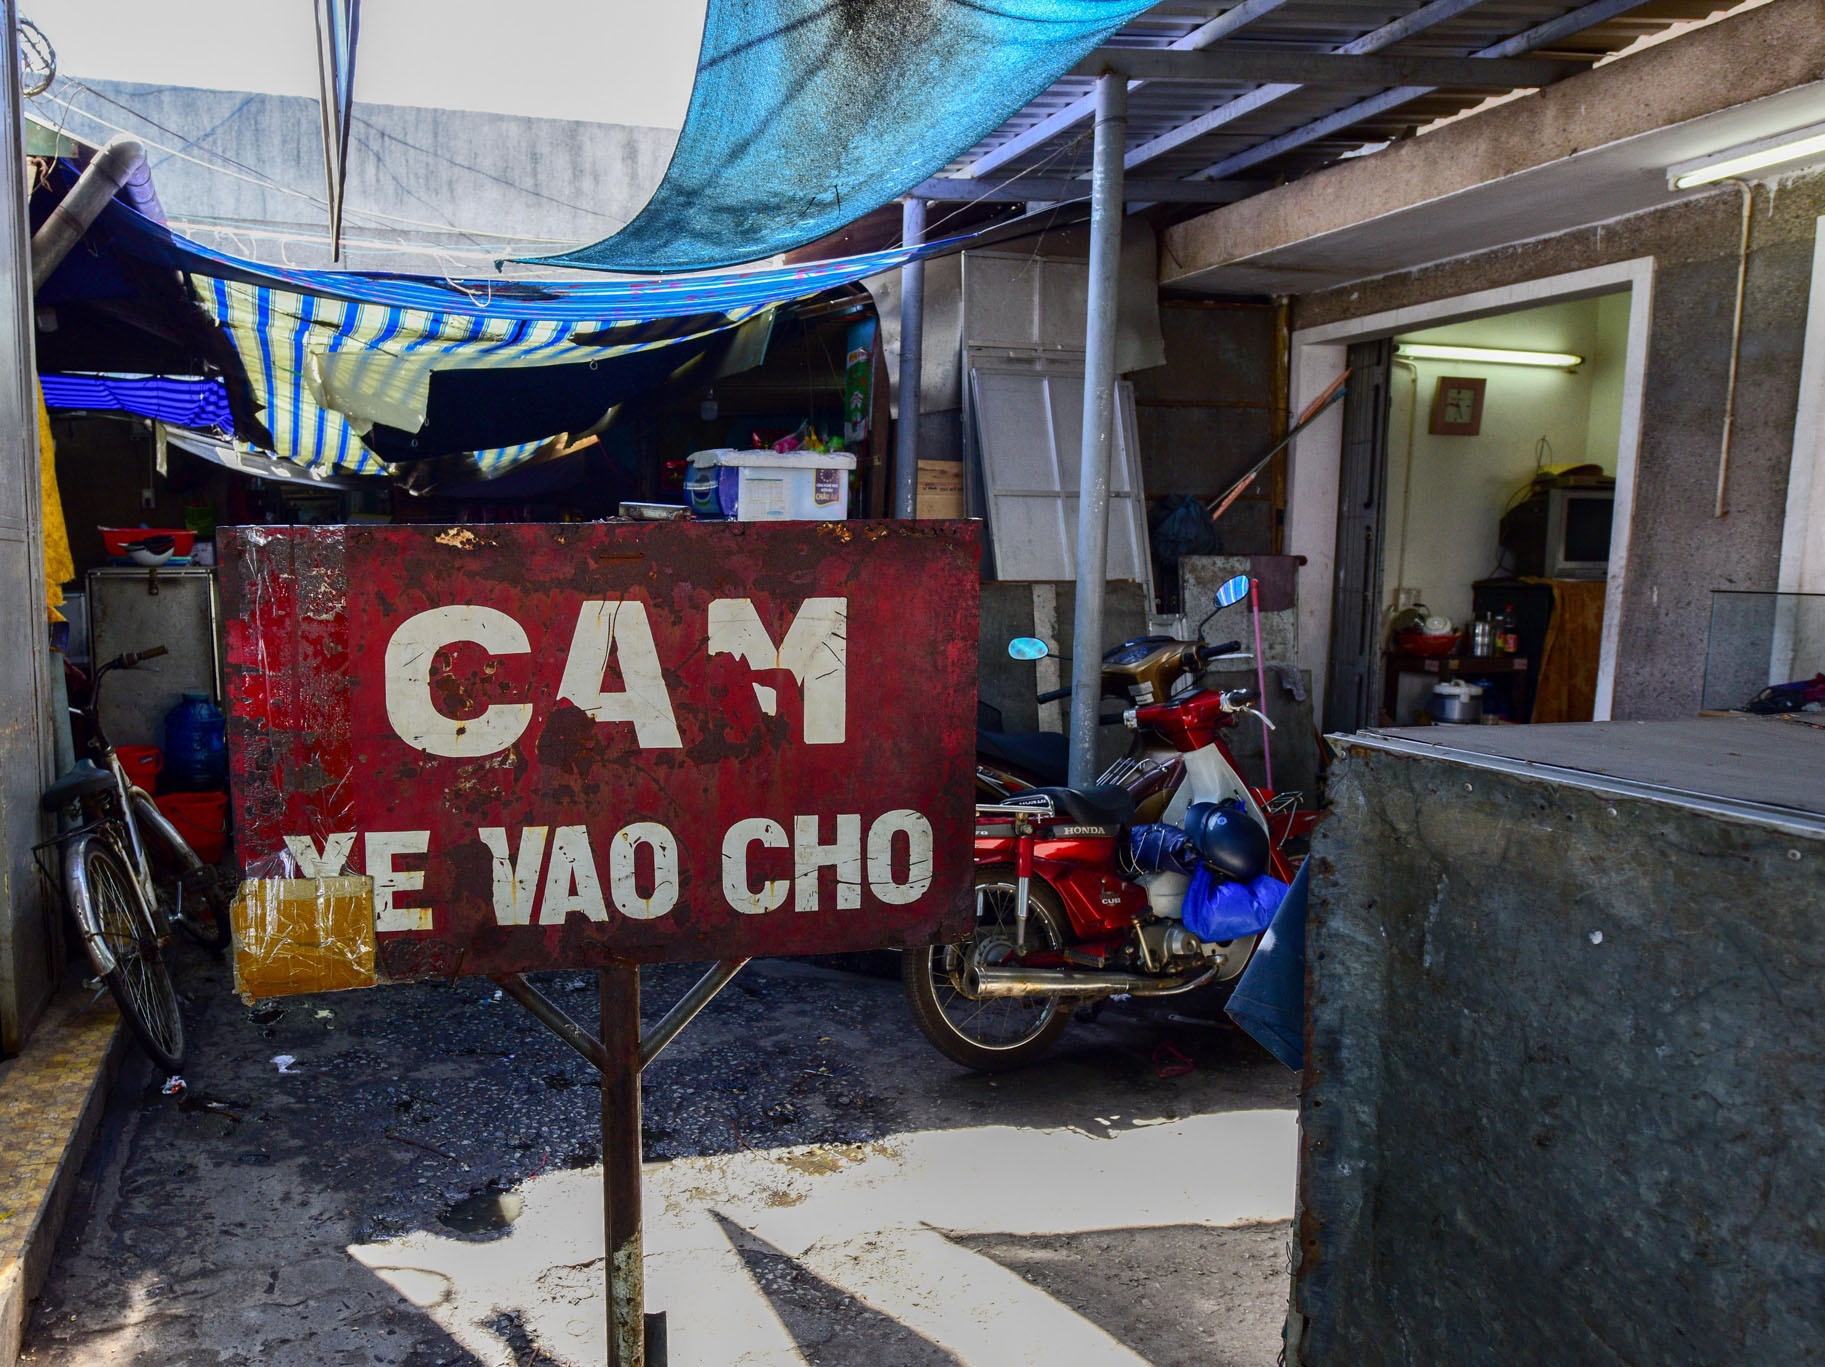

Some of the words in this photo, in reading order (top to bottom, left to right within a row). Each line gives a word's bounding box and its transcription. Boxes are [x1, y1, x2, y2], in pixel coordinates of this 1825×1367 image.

[385, 597, 847, 757] CAM
[1063, 826, 1106, 836] HONDA
[478, 818, 679, 926] VAO
[721, 809, 933, 915] CHO
[1101, 897, 1122, 905] CUB
